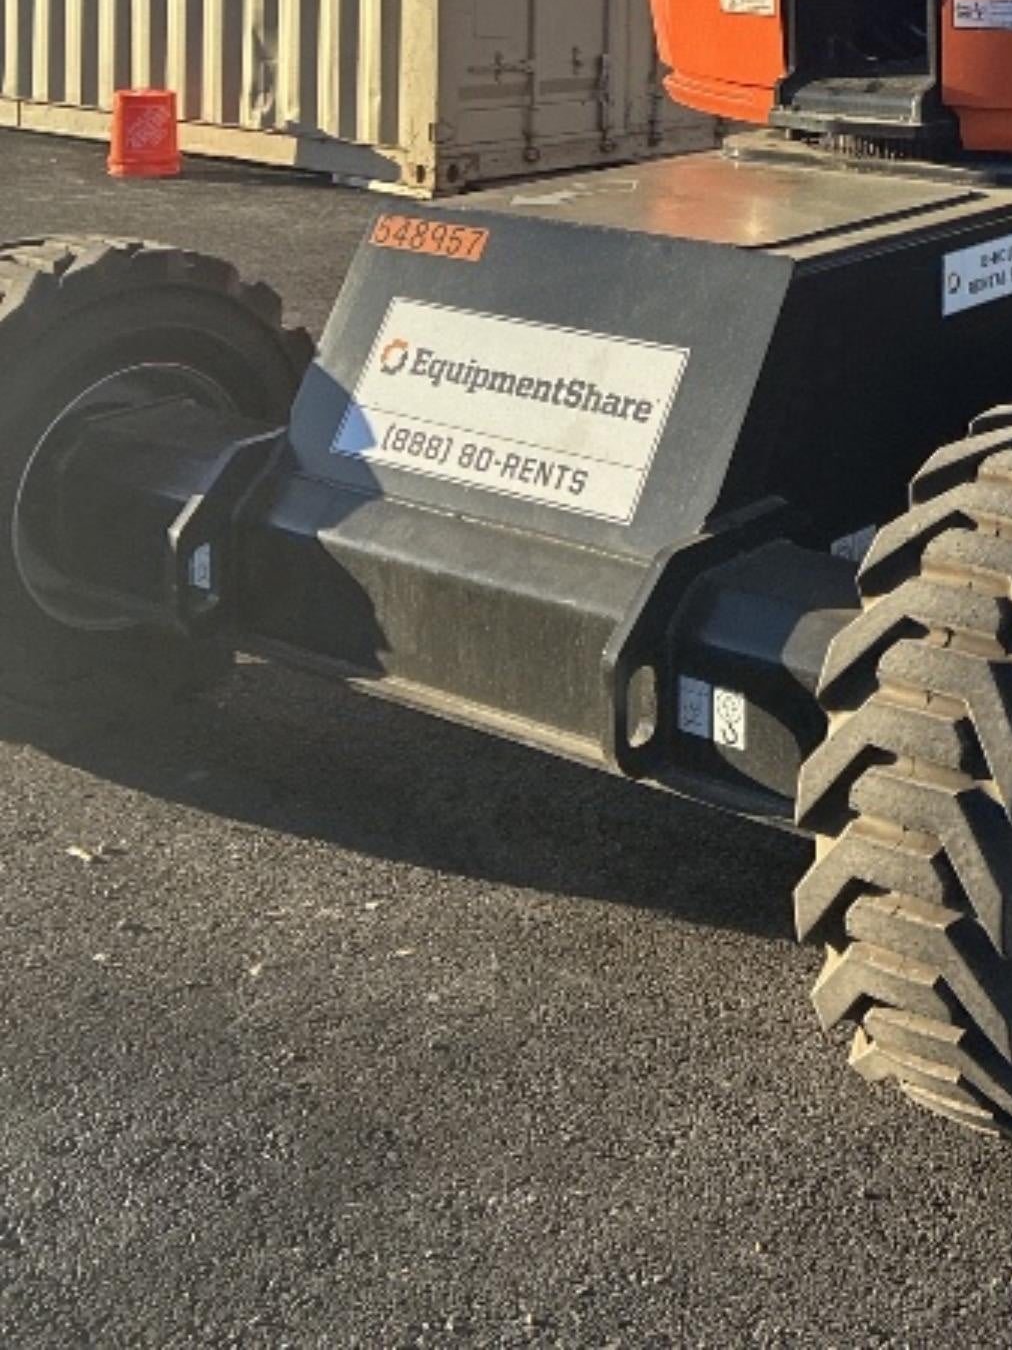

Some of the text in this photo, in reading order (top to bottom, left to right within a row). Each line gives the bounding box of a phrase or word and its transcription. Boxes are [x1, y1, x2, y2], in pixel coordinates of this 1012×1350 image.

[374, 216, 485, 256] 548957
[409, 347, 654, 424] EquipmentShare
[381, 423, 589, 496] (888) 80-RENTS
